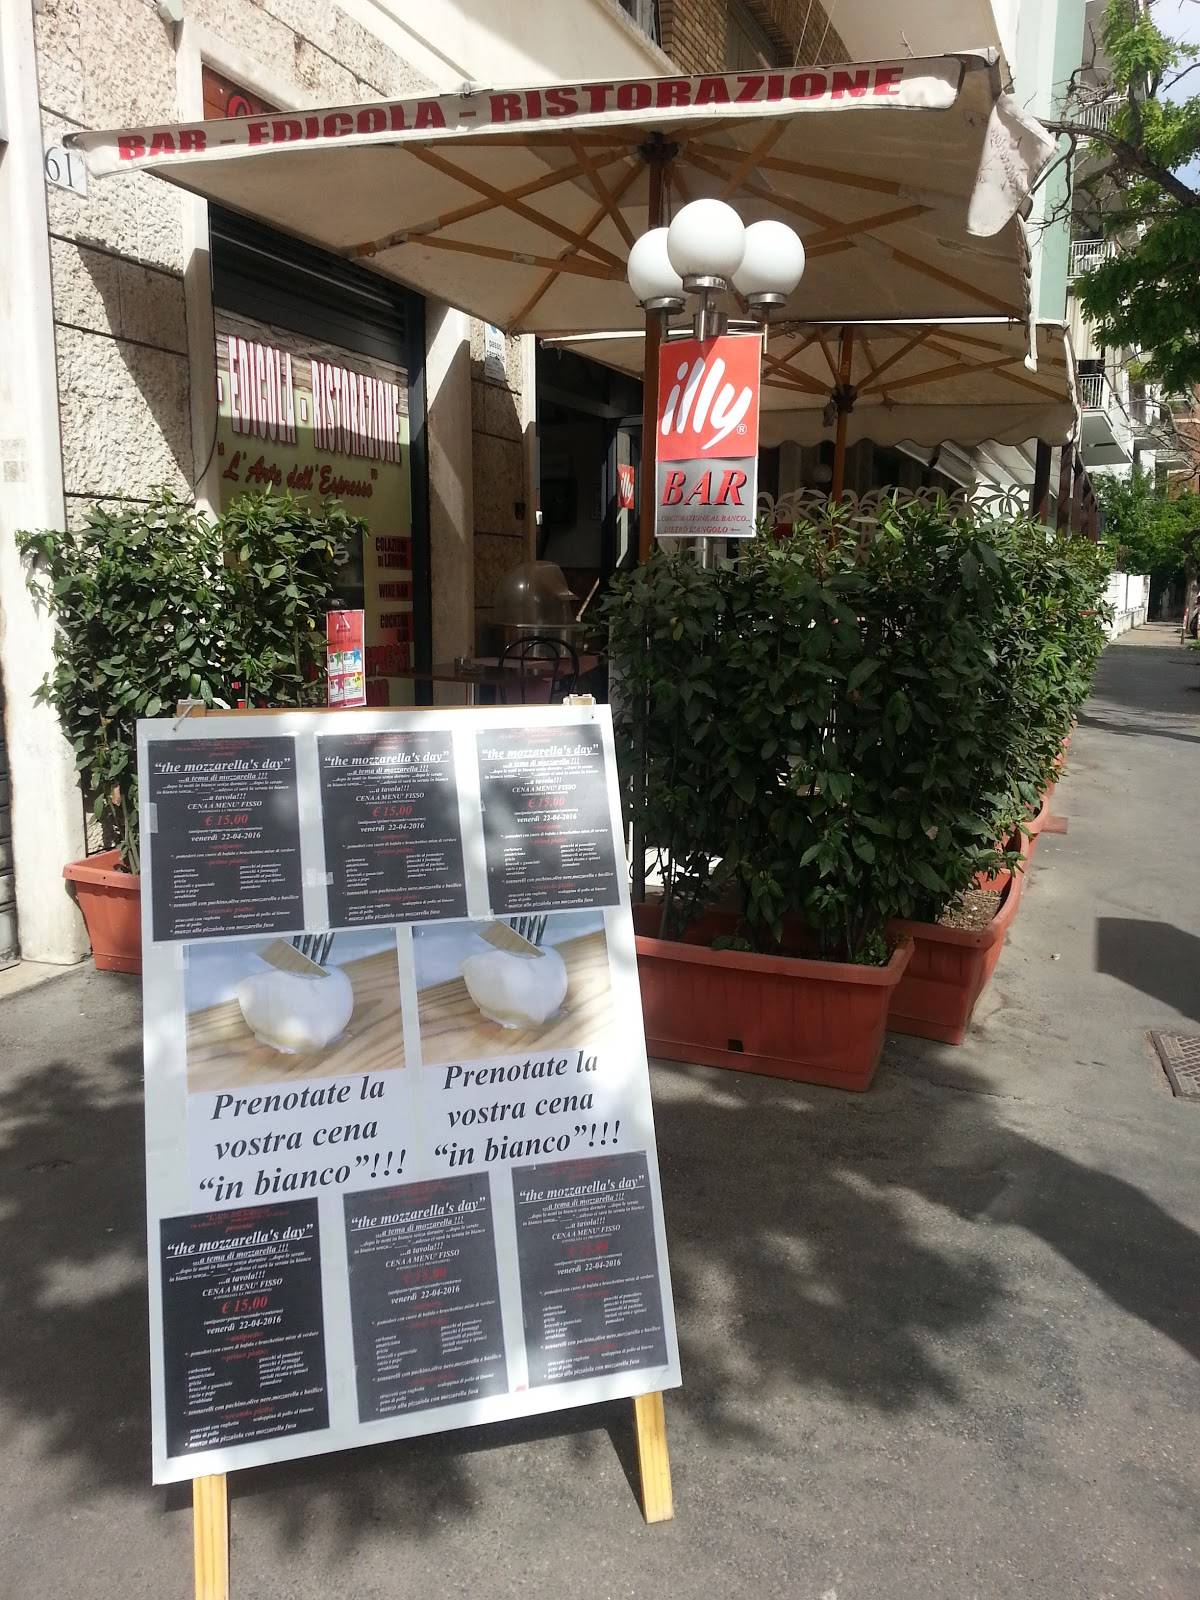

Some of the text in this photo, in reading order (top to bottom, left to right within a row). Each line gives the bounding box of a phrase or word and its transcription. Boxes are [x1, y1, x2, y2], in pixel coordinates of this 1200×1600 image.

[117, 129, 207, 161] BAR
[247, 101, 447, 147] EDICOLA
[489, 67, 904, 123] RISTORAZIONE
[45, 146, 74, 188] 61
[229, 335, 401, 464] EDICOLA RISTORAZIONE
[661, 357, 753, 450] illy
[660, 469, 748, 507] BAR
[154, 758, 290, 772] “the mozzarella's day”
[324, 751, 449, 766] “the mozzarella's day”
[191, 831, 260, 841] venerdì 22-04-2016
[360, 822, 424, 832] venerdì 22-04-2016
[442, 1050, 598, 1090] Prenotate la
[209, 1075, 385, 1121] Prenotate la
[447, 1092, 594, 1128] vostra cena
[214, 1121, 378, 1161] vostra cena
[434, 1141, 475, 1168] “in
[199, 1175, 244, 1202] “in
[519, 1174, 645, 1202] “the mozzarella's day”
[351, 1196, 486, 1229] “the mozzarella's day”
[167, 1223, 313, 1256] “the mozzarella's day”
[551, 1231, 571, 1240] CENA
[577, 1227, 600, 1236] MENU'
[600, 1224, 621, 1233] FISSO
[385, 1257, 406, 1267] CENA
[413, 1252, 437, 1263] MENU'
[438, 1248, 460, 1259] FISSO
[412, 1241, 444, 1253] tavola!!!
[202, 1286, 224, 1296] CENA
[232, 1281, 259, 1292] MENU'
[259, 1277, 283, 1288] FISSO
[231, 1270, 266, 1282] tavola!!!
[390, 1292, 417, 1304] venerdì
[420, 1284, 460, 1299] 22-04-2016
[206, 1322, 235, 1334] venerdì
[238, 1315, 281, 1329] 22-04-2016
